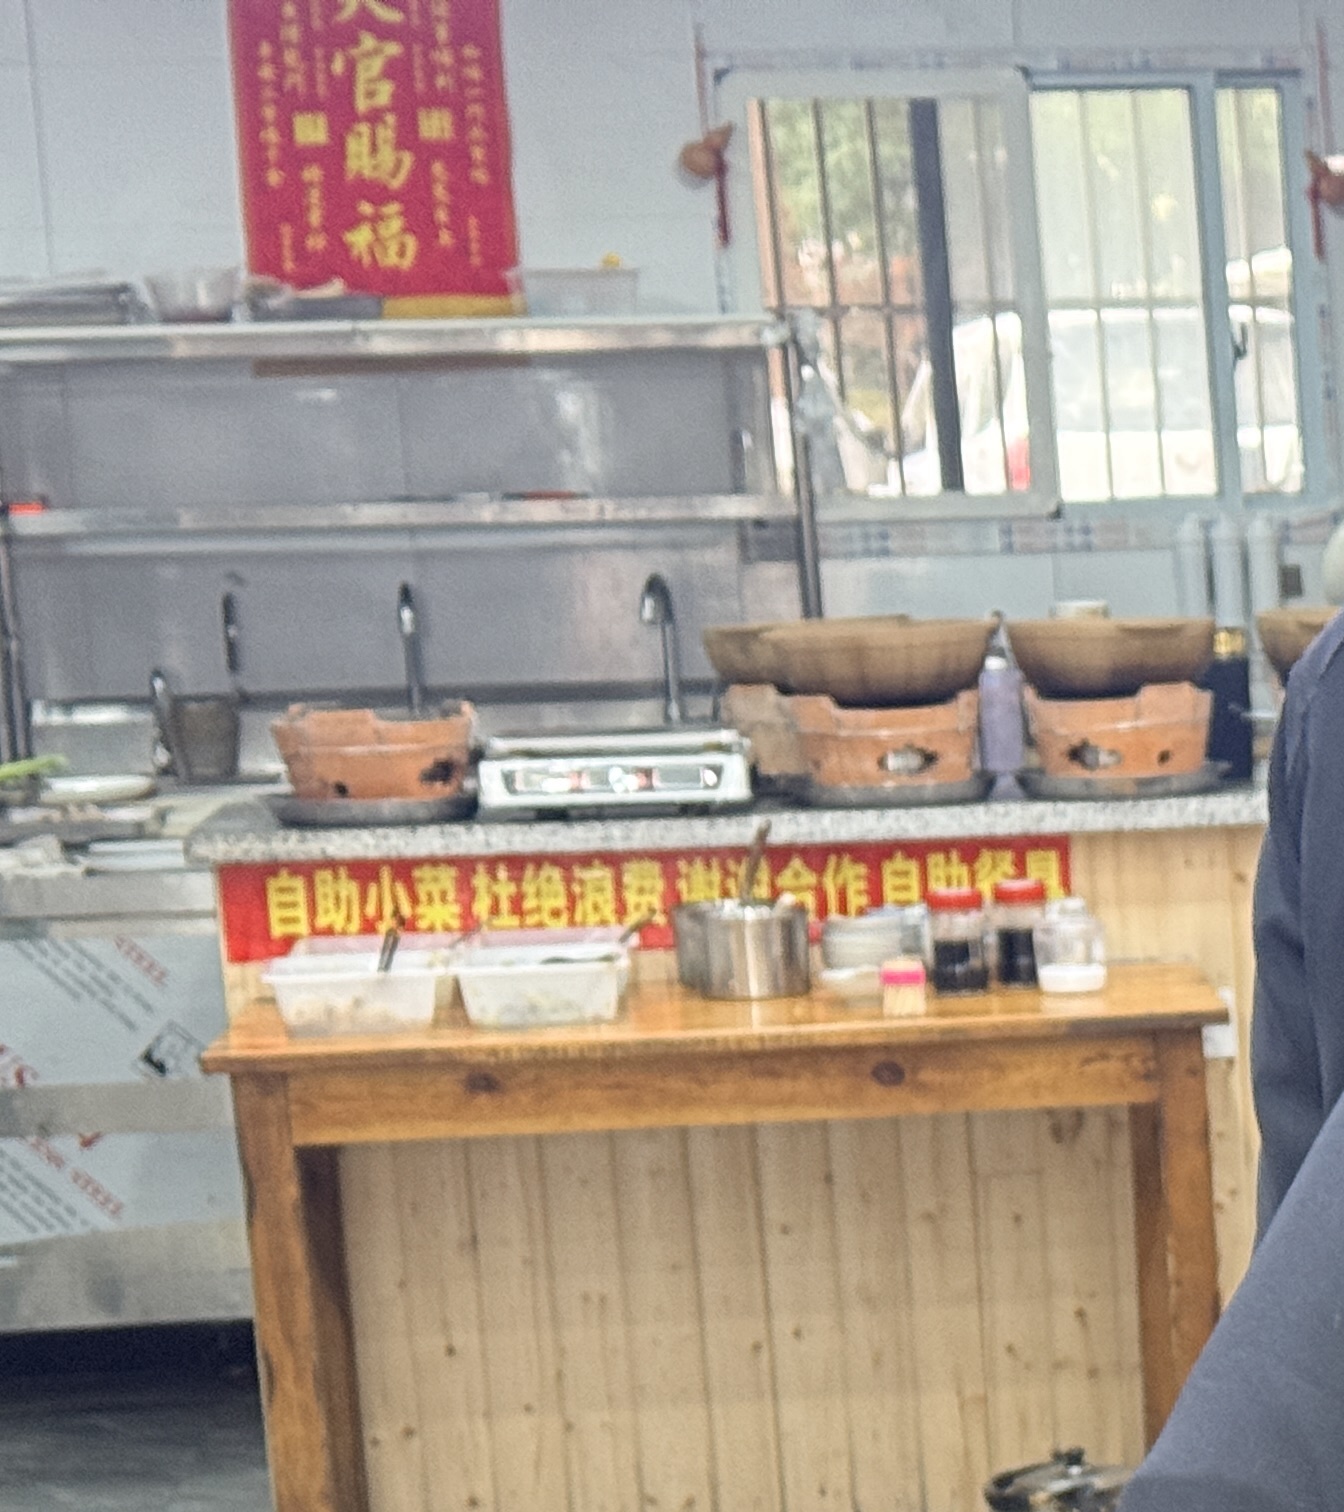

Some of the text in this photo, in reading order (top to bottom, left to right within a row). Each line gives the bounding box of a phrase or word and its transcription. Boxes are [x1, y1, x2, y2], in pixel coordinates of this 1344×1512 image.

[266, 862, 462, 941] 自助小菜
[472, 857, 669, 930] 杜绝浪费
